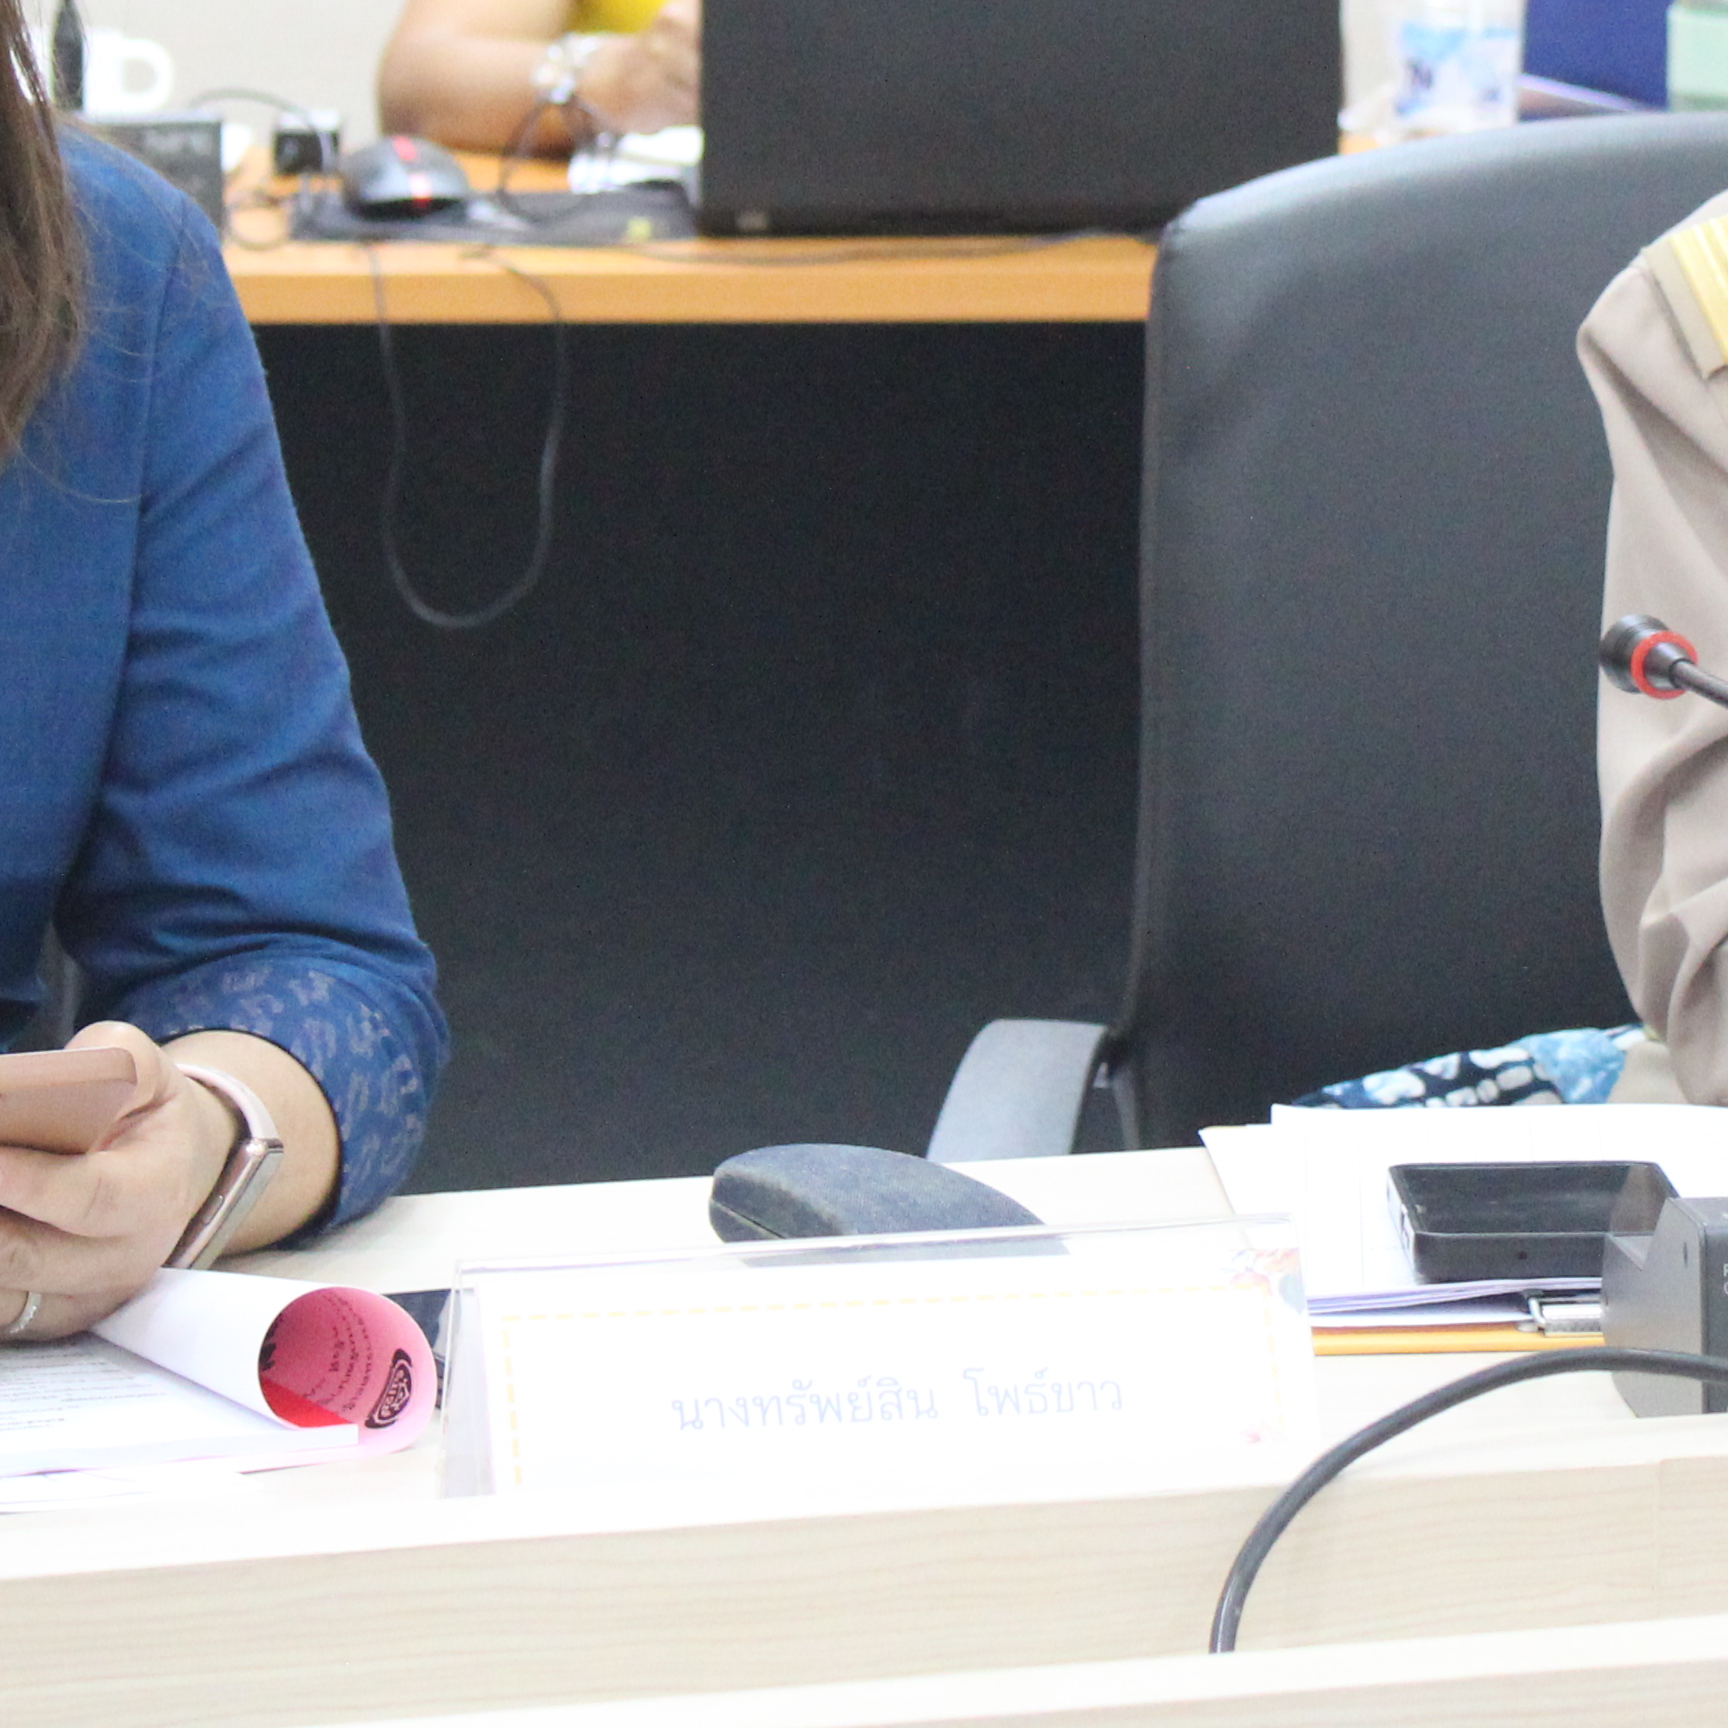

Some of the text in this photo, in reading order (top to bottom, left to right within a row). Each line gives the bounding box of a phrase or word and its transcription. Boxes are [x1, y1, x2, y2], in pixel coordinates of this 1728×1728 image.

[670, 1374, 939, 1431] นางทรัพย์สิน
